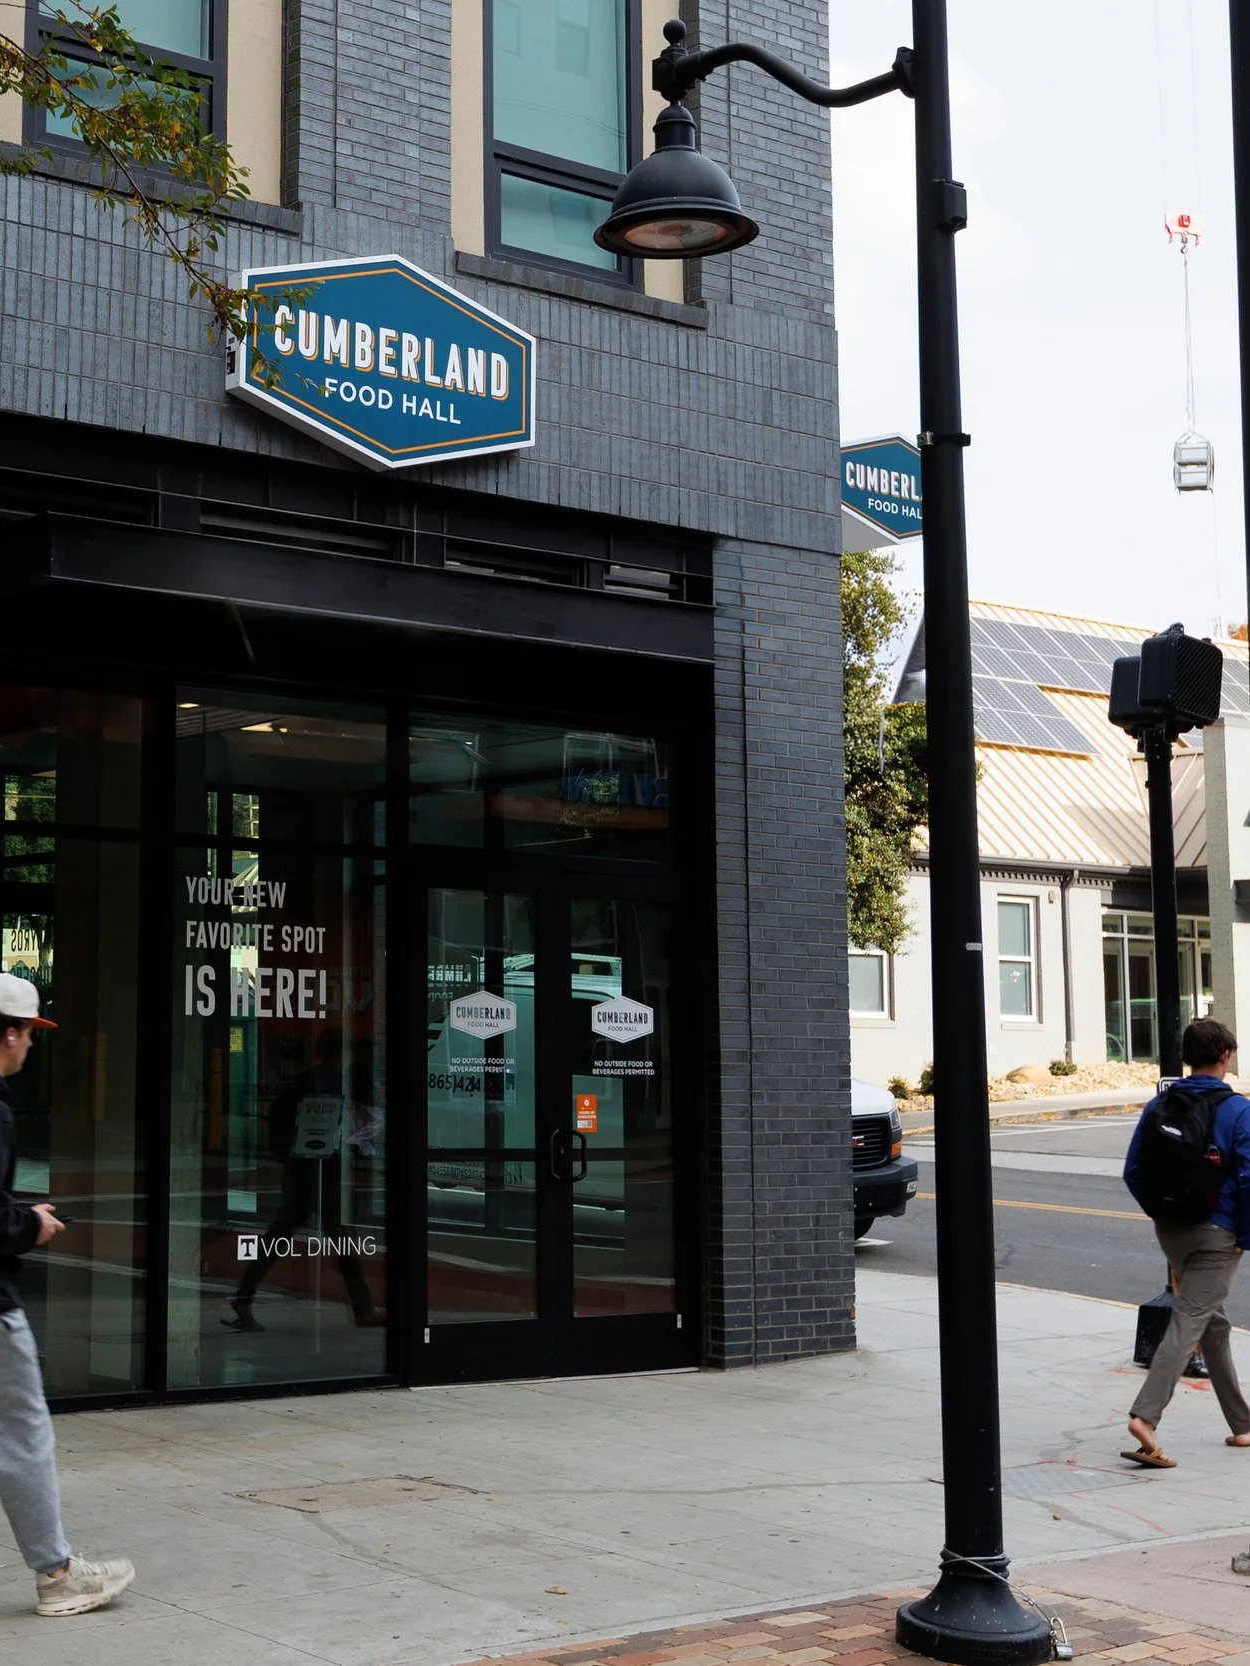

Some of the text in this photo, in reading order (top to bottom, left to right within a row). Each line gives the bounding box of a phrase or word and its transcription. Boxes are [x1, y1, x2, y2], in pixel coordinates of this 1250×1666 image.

[273, 304, 509, 401] CUMBERLAND
[324, 377, 461, 425] FOOD HALL
[846, 461, 922, 503] CUMBERL
[868, 497, 899, 515] FOOD
[185, 875, 287, 909] YOUR NEW
[185, 920, 327, 954] FAVORITE SPOT
[184, 964, 216, 1017] IS
[230, 967, 327, 1019] HERE!
[455, 1006, 511, 1020] CUMBERLAND
[484, 1021, 500, 1029] HALL
[597, 1011, 648, 1025] CUMBERLAND
[260, 1237, 301, 1258] VOL
[307, 1236, 376, 1257] DINING
